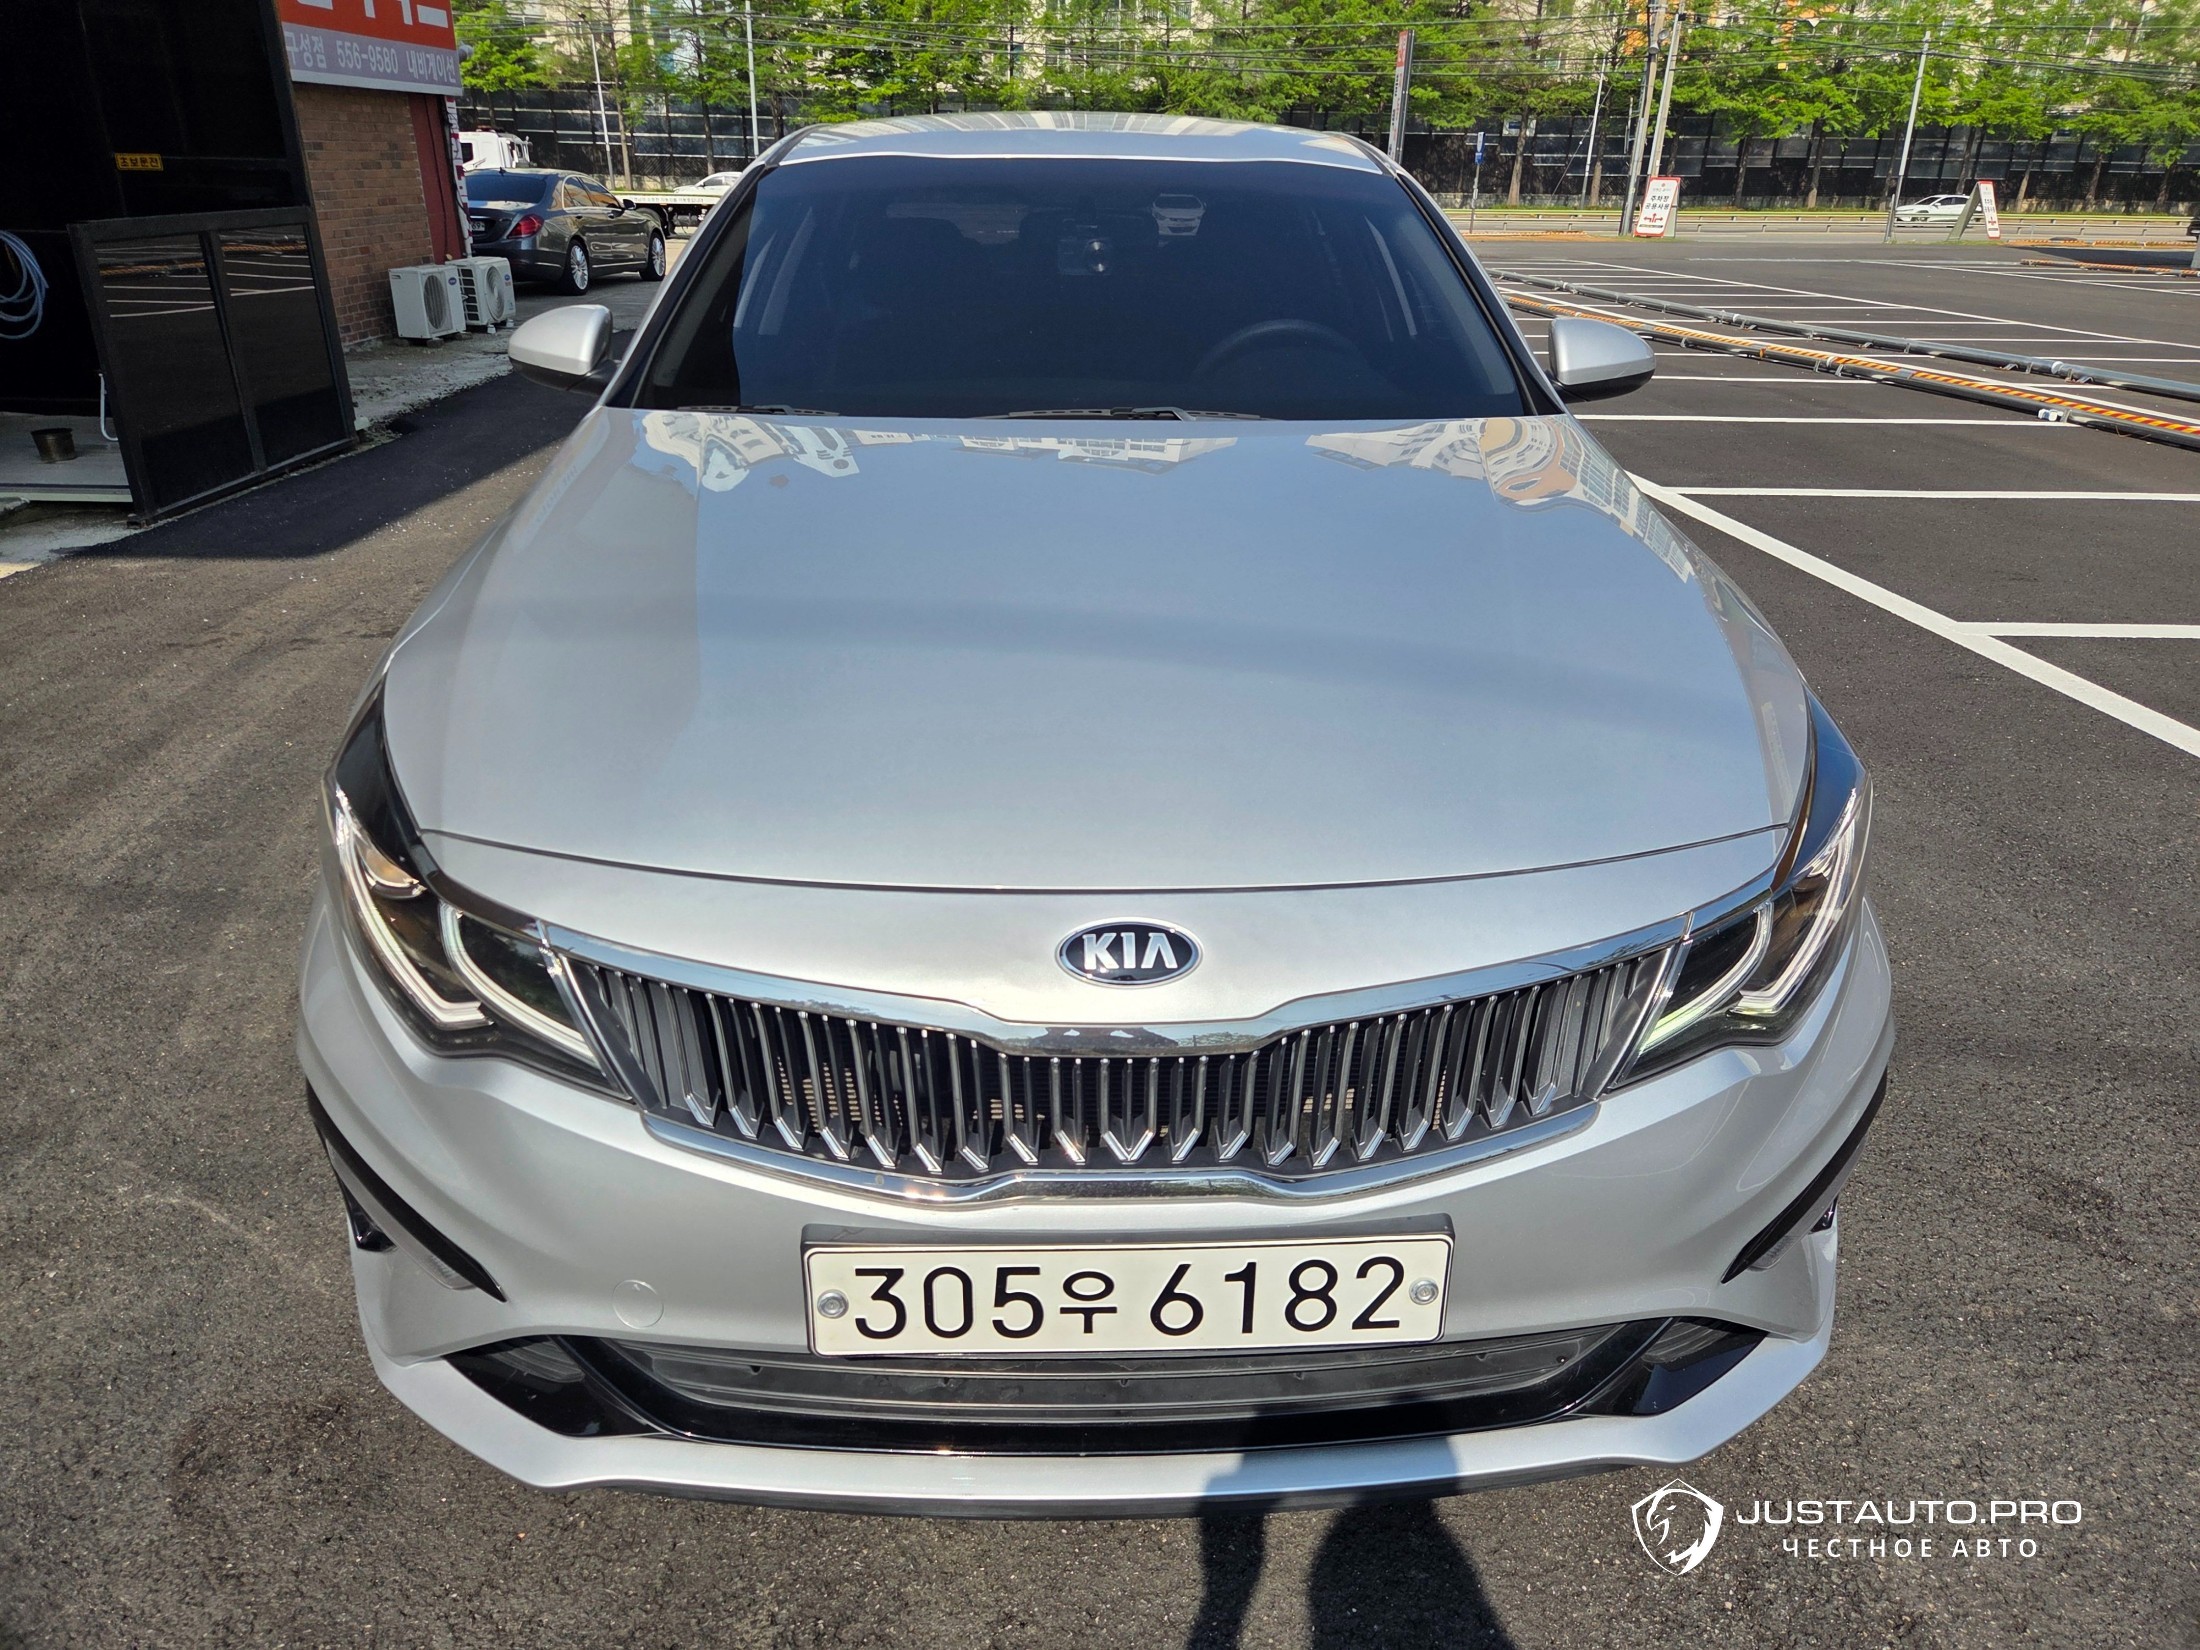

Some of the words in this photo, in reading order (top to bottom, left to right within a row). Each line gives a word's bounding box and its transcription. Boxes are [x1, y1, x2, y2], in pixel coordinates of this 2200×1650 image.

[336, 40, 398, 74] 556-9580
[406, 50, 456, 83] 내비게이션
[1082, 932, 1178, 971] KIA
[854, 1265, 1118, 1340] 305우
[1149, 1256, 1401, 1337] 6182
